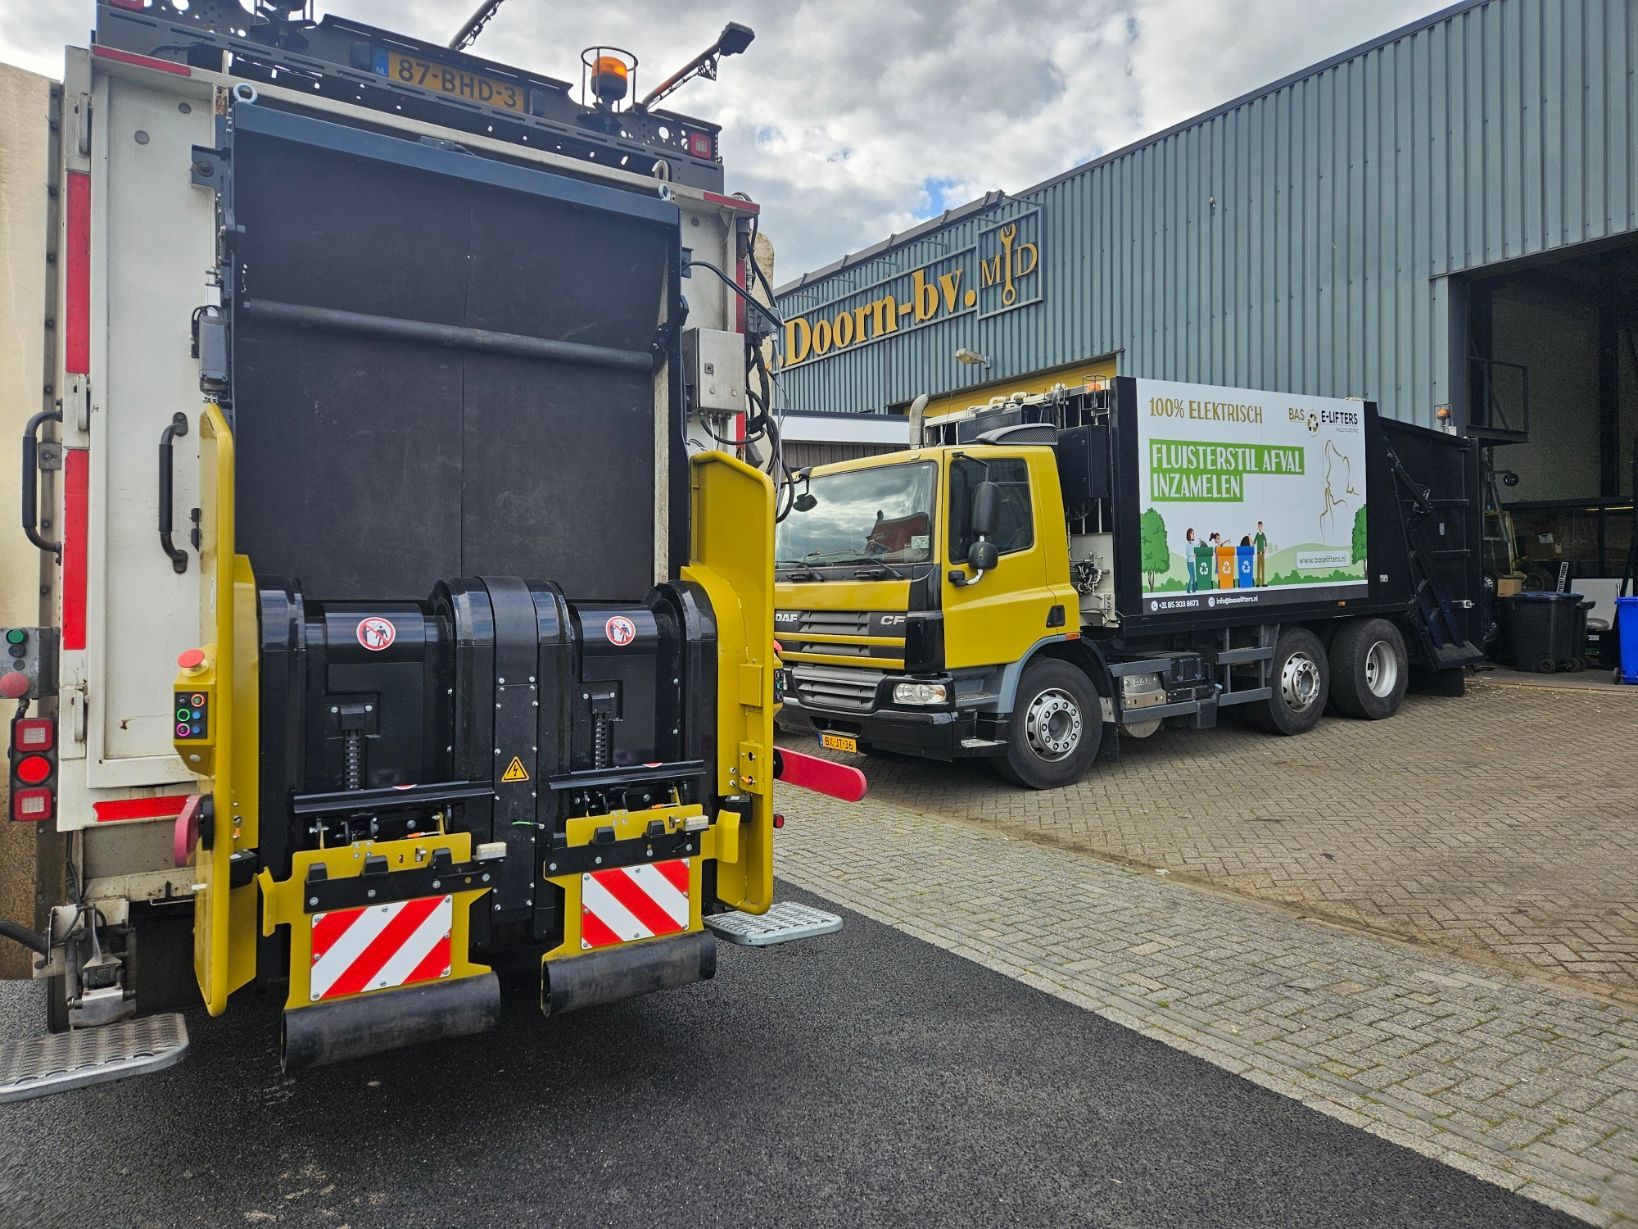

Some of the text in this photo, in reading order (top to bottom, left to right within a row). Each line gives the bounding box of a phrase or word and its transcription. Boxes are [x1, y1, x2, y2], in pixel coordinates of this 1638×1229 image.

[375, 65, 388, 76] NL
[398, 59, 516, 108] 87-BHD-3
[1149, 397, 1263, 424] 100% ELEKTRISCH
[1288, 407, 1305, 421] BAS
[1321, 410, 1359, 425] E-LIFTERS
[1152, 444, 1303, 473] FLUISTERSTIL AFVAL
[1153, 473, 1240, 498] INZAMELEN
[775, 613, 798, 623] DAF
[880, 615, 907, 626] CF
